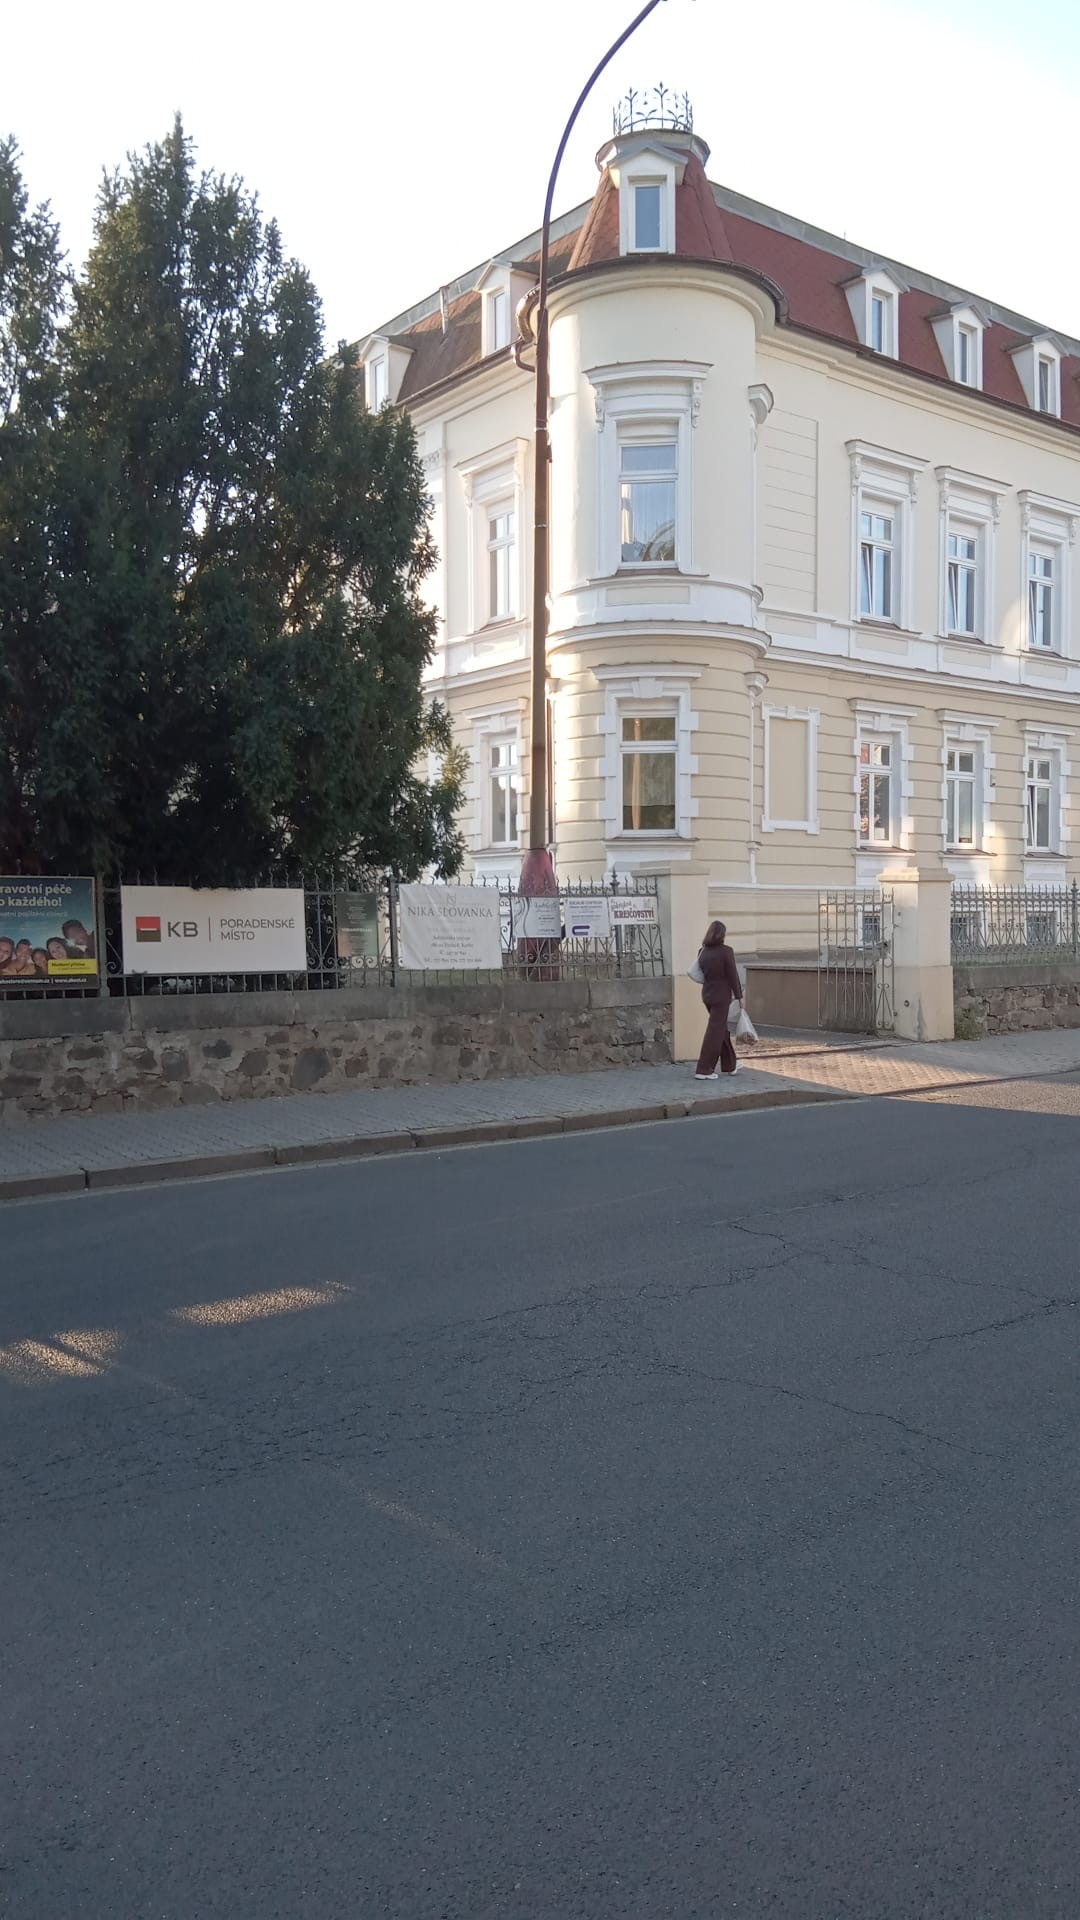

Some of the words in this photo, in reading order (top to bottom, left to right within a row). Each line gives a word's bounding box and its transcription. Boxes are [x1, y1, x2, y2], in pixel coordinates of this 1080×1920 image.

[45, 884, 73, 896] péče
[8, 896, 62, 907] každého!
[407, 906, 435, 917] NIKA
[220, 917, 296, 929] PORADENSKÉ
[167, 921, 199, 938] KB
[220, 929, 256, 941] MÍSTO
